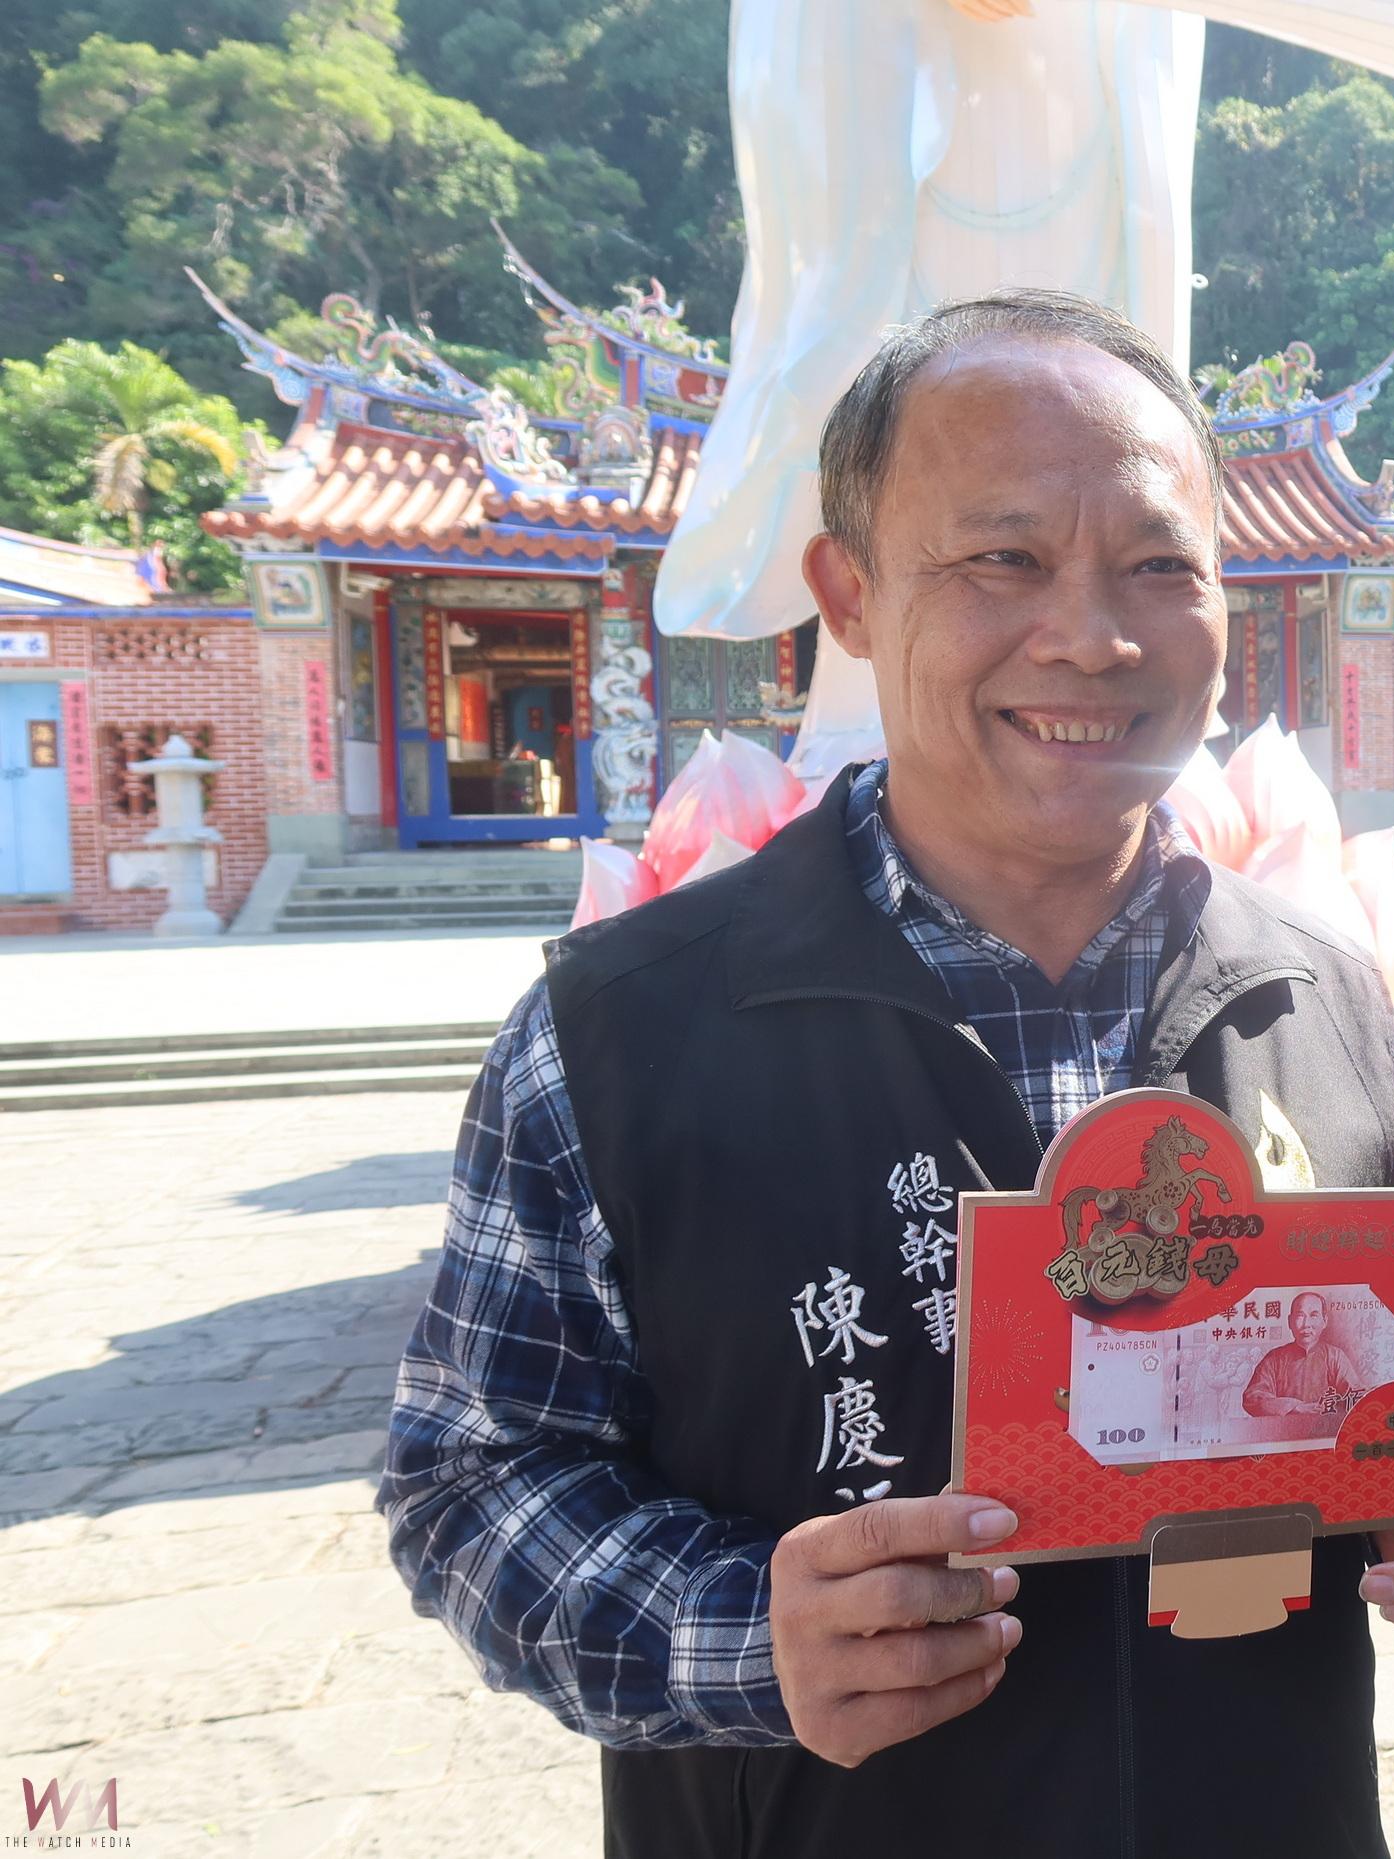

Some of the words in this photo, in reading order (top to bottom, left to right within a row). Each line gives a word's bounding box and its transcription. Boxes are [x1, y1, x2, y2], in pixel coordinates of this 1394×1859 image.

[1190, 1217, 1259, 1237] 一馬當先
[886, 1151, 957, 1355] 總幹事
[1045, 1235, 1239, 1301] 百元錢母
[1204, 1301, 1282, 1322] 華民國
[1212, 1326, 1267, 1341] 中央銀行
[1096, 1340, 1158, 1352] PZ404785CN
[790, 1265, 905, 1501] 陳慶
[1096, 1427, 1146, 1446] 100
